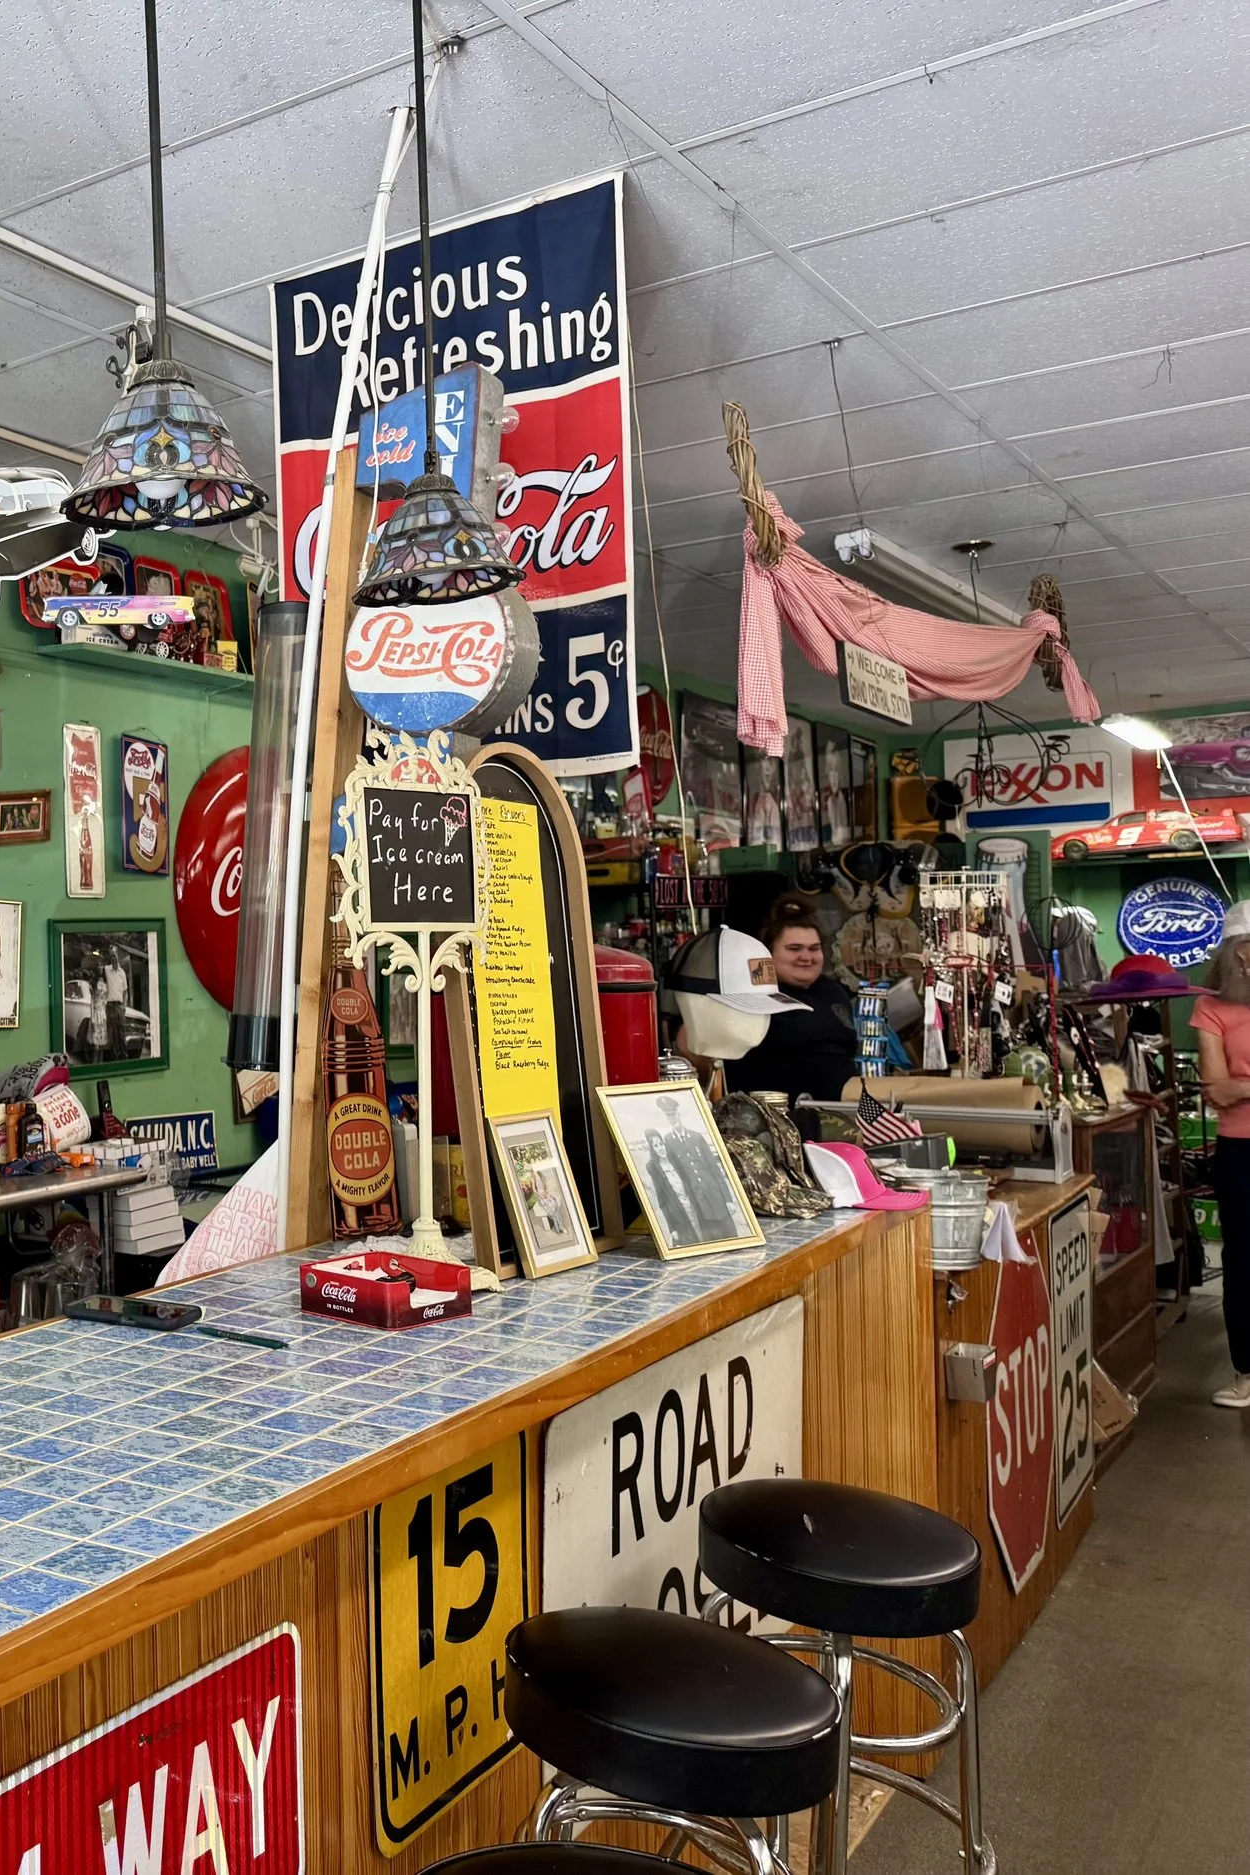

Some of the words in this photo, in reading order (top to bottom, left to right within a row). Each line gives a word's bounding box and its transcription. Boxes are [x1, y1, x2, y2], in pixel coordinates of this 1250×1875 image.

[292, 255, 528, 357] Delicious
[340, 291, 613, 410] Refreshing
[97, 602, 121, 618] 55
[855, 650, 898, 685] WELCOME
[969, 761, 1105, 804] EXXON
[369, 799, 403, 838] Pay
[410, 802, 439, 832] for
[372, 834, 408, 864] Ice
[415, 847, 465, 866] cream
[1116, 827, 1145, 846] 9
[393, 873, 454, 906] Here
[660, 880, 679, 904] LOST
[1135, 881, 1207, 904] GENUINE
[1133, 907, 1210, 934] Ford
[336, 998, 362, 1007] DOUBLE
[341, 1006, 359, 1016] COLA
[334, 1111, 340, 1121] A
[340, 1103, 361, 1118] GREAT
[362, 1103, 382, 1118] DRINK
[335, 1130, 387, 1151] DOUBLE
[344, 1153, 381, 1170] COLA
[336, 1179, 342, 1188] A
[342, 1184, 366, 1196] MIGHTY
[367, 1173, 390, 1195] FLAVOR
[1055, 1231, 1088, 1297] SPEED
[321, 1281, 358, 1303] Coca-Cola
[332, 1304, 354, 1314] BOTTLES
[422, 1303, 445, 1319] Coca-Cola
[1060, 1289, 1086, 1355] LIMIT
[995, 1324, 1049, 1487] STOP
[1059, 1349, 1089, 1484] 25
[612, 1355, 754, 1558] ROAD
[407, 1462, 500, 1670] 15
[98, 1695, 281, 1875] WAY
